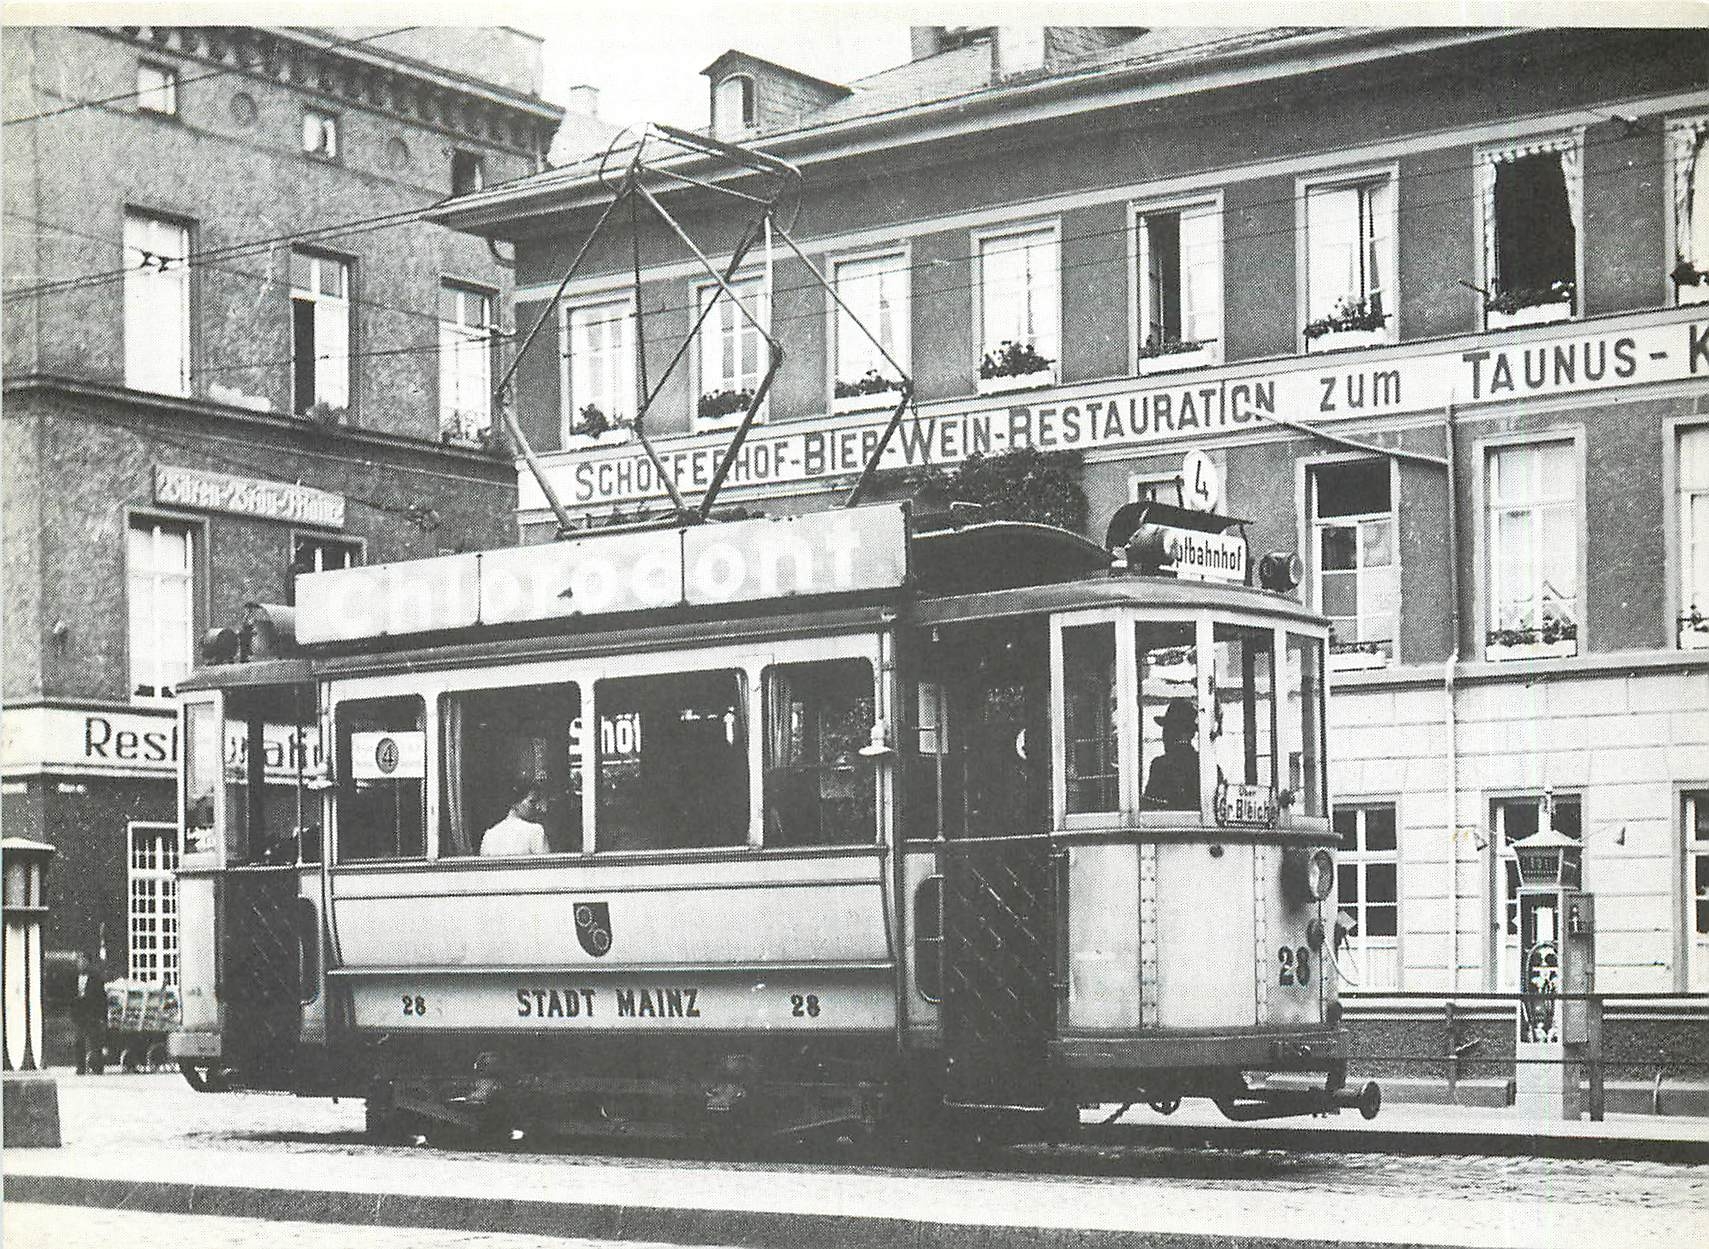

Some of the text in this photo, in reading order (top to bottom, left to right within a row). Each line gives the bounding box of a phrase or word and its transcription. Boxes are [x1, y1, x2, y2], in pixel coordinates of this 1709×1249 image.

[1195, 459, 1209, 501] 4
[382, 742, 395, 768] 4
[1278, 945, 1311, 987] 28
[402, 994, 427, 1017] 28
[517, 988, 700, 1018] STADT MAINZ
[789, 994, 820, 1018] 28
